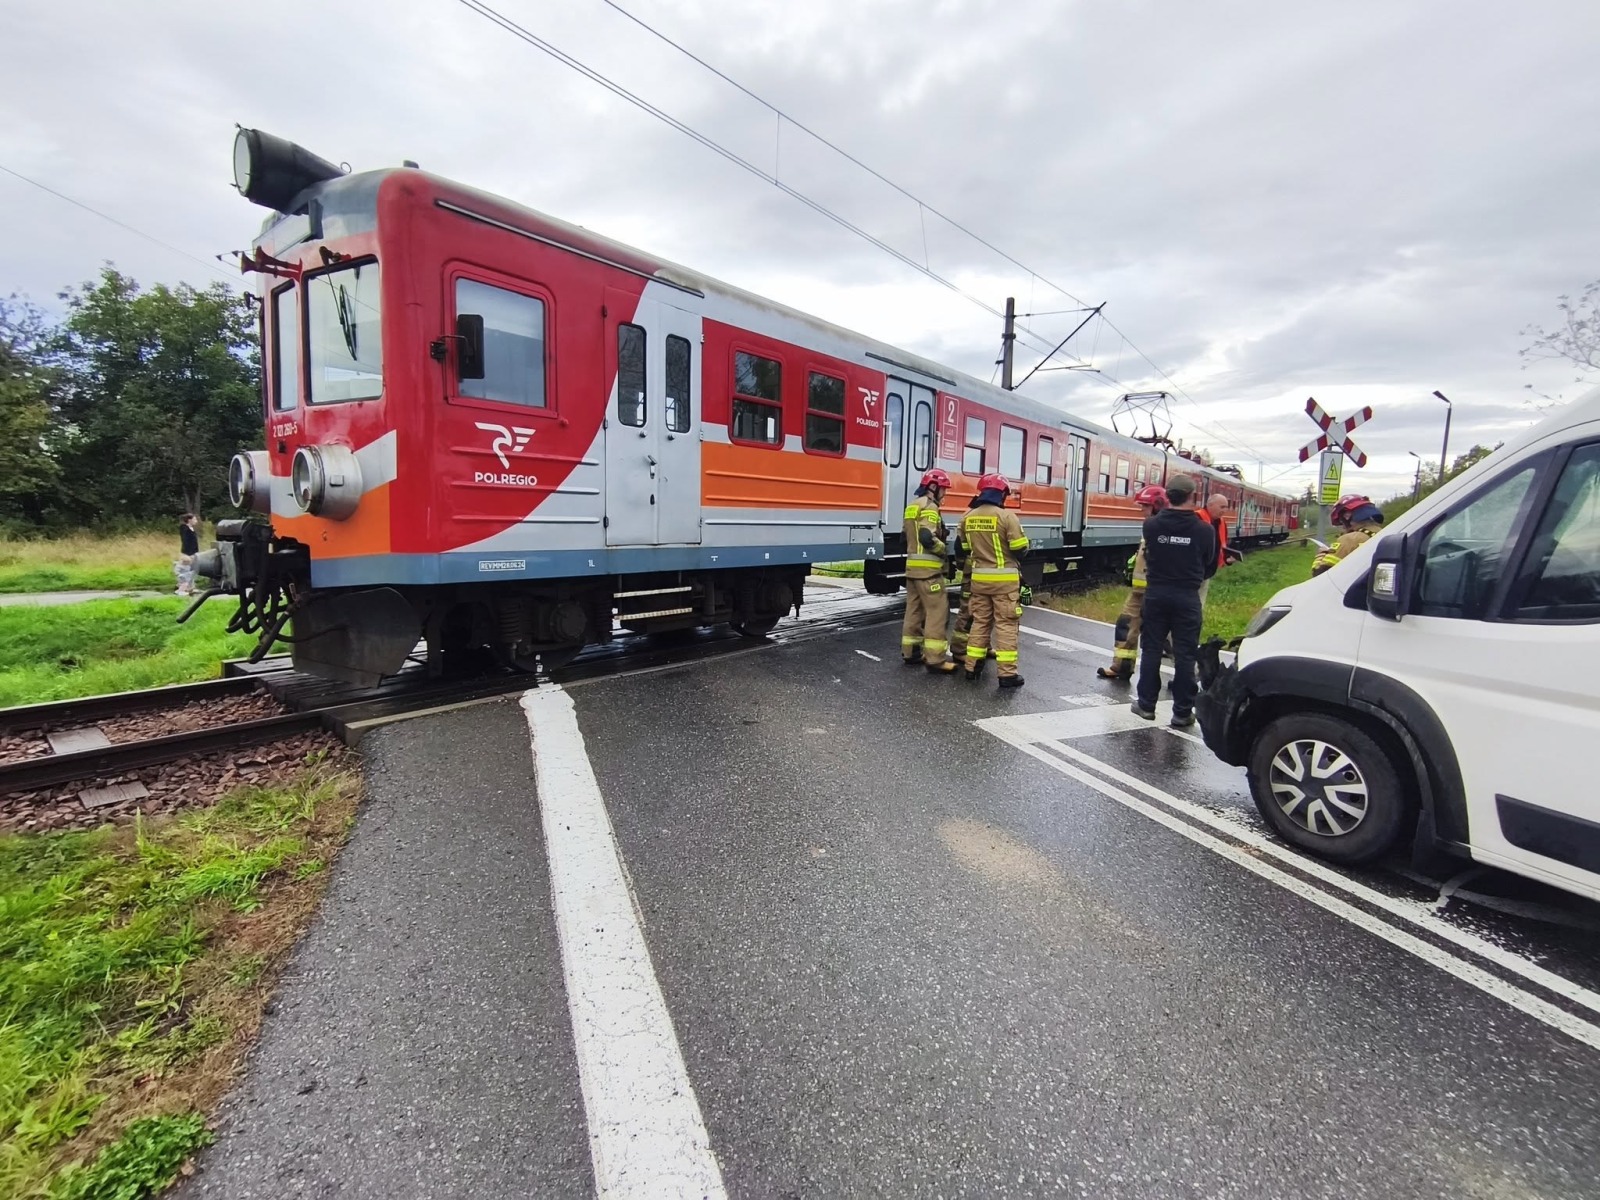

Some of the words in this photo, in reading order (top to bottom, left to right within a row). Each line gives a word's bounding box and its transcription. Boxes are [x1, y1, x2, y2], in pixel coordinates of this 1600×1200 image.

[948, 400, 955, 423] 2
[856, 416, 879, 428] POLREGIO
[474, 471, 538, 486] POLREGIO
